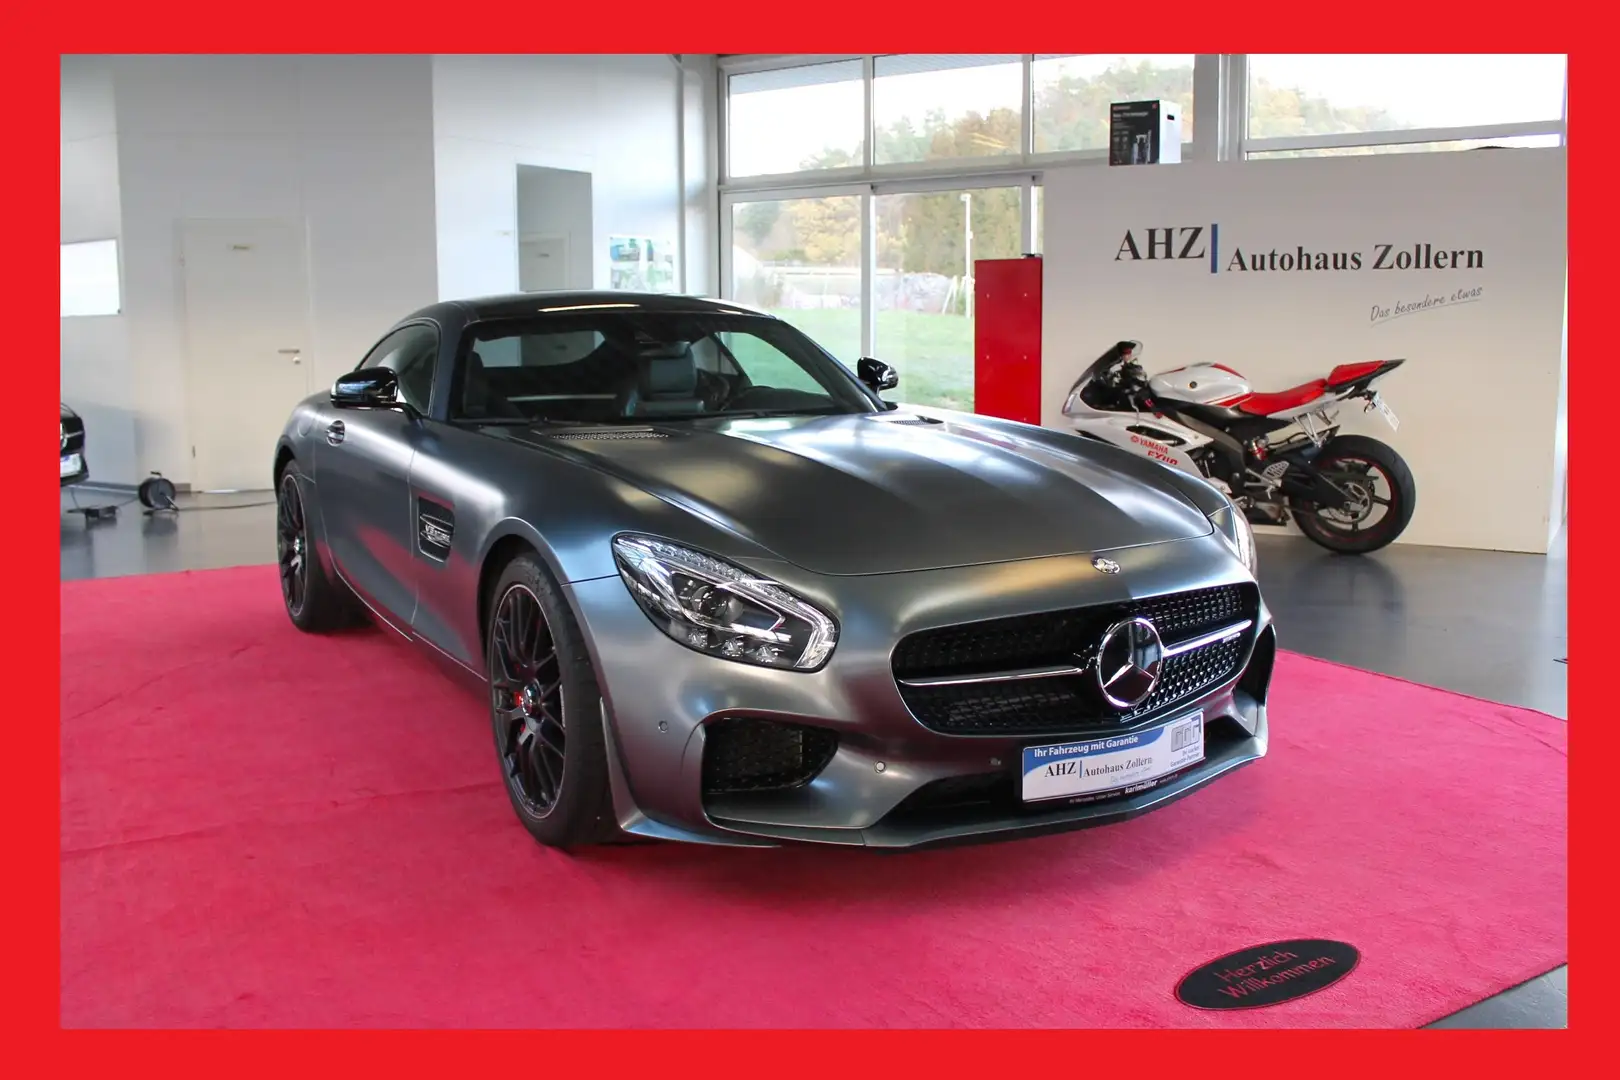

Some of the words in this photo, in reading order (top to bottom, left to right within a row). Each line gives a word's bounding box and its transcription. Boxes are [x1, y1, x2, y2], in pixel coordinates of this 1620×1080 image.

[1114, 226, 1206, 261] AHZ
[1226, 245, 1362, 272] Autohaus
[1372, 243, 1484, 270] Zollern
[1370, 305, 1390, 321] Das
[1394, 294, 1445, 315] besondere
[1451, 286, 1483, 302] etwas
[1140, 438, 1169, 454] YAMAHA
[1034, 748, 1047, 758] Ihr
[1048, 744, 1089, 756] Fahrzeug
[1090, 739, 1105, 750] mit
[1105, 735, 1138, 748] Garantie
[1044, 761, 1077, 778] AHZ
[1084, 763, 1124, 777] Autohaus
[1125, 756, 1153, 768] Zollern
[1213, 950, 1299, 983] Herzlich
[1217, 956, 1337, 999] Willkommen
